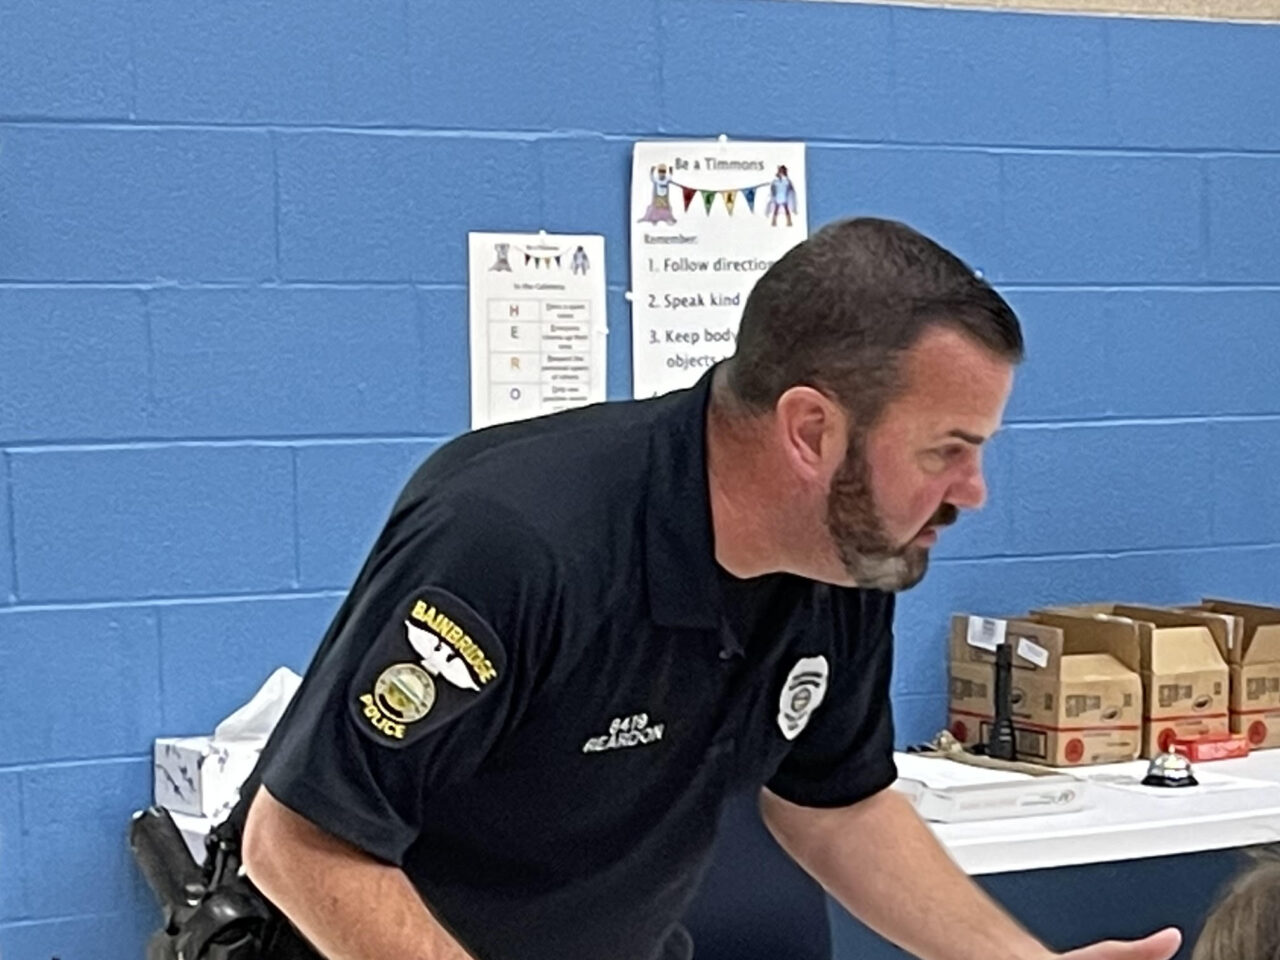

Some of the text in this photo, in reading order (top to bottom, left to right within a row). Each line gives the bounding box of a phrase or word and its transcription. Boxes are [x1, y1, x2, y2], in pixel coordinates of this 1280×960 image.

[675, 156, 765, 171] Be a Timmons
[664, 257, 709, 272] Follow
[664, 293, 705, 310] Speak
[710, 292, 740, 306] kind
[509, 305, 519, 317] H
[511, 326, 519, 339] E
[665, 329, 700, 345] Keep
[510, 357, 520, 370] R
[509, 387, 521, 400] O
[411, 599, 498, 684] BAINBRIDGE
[359, 693, 407, 739] POLICE
